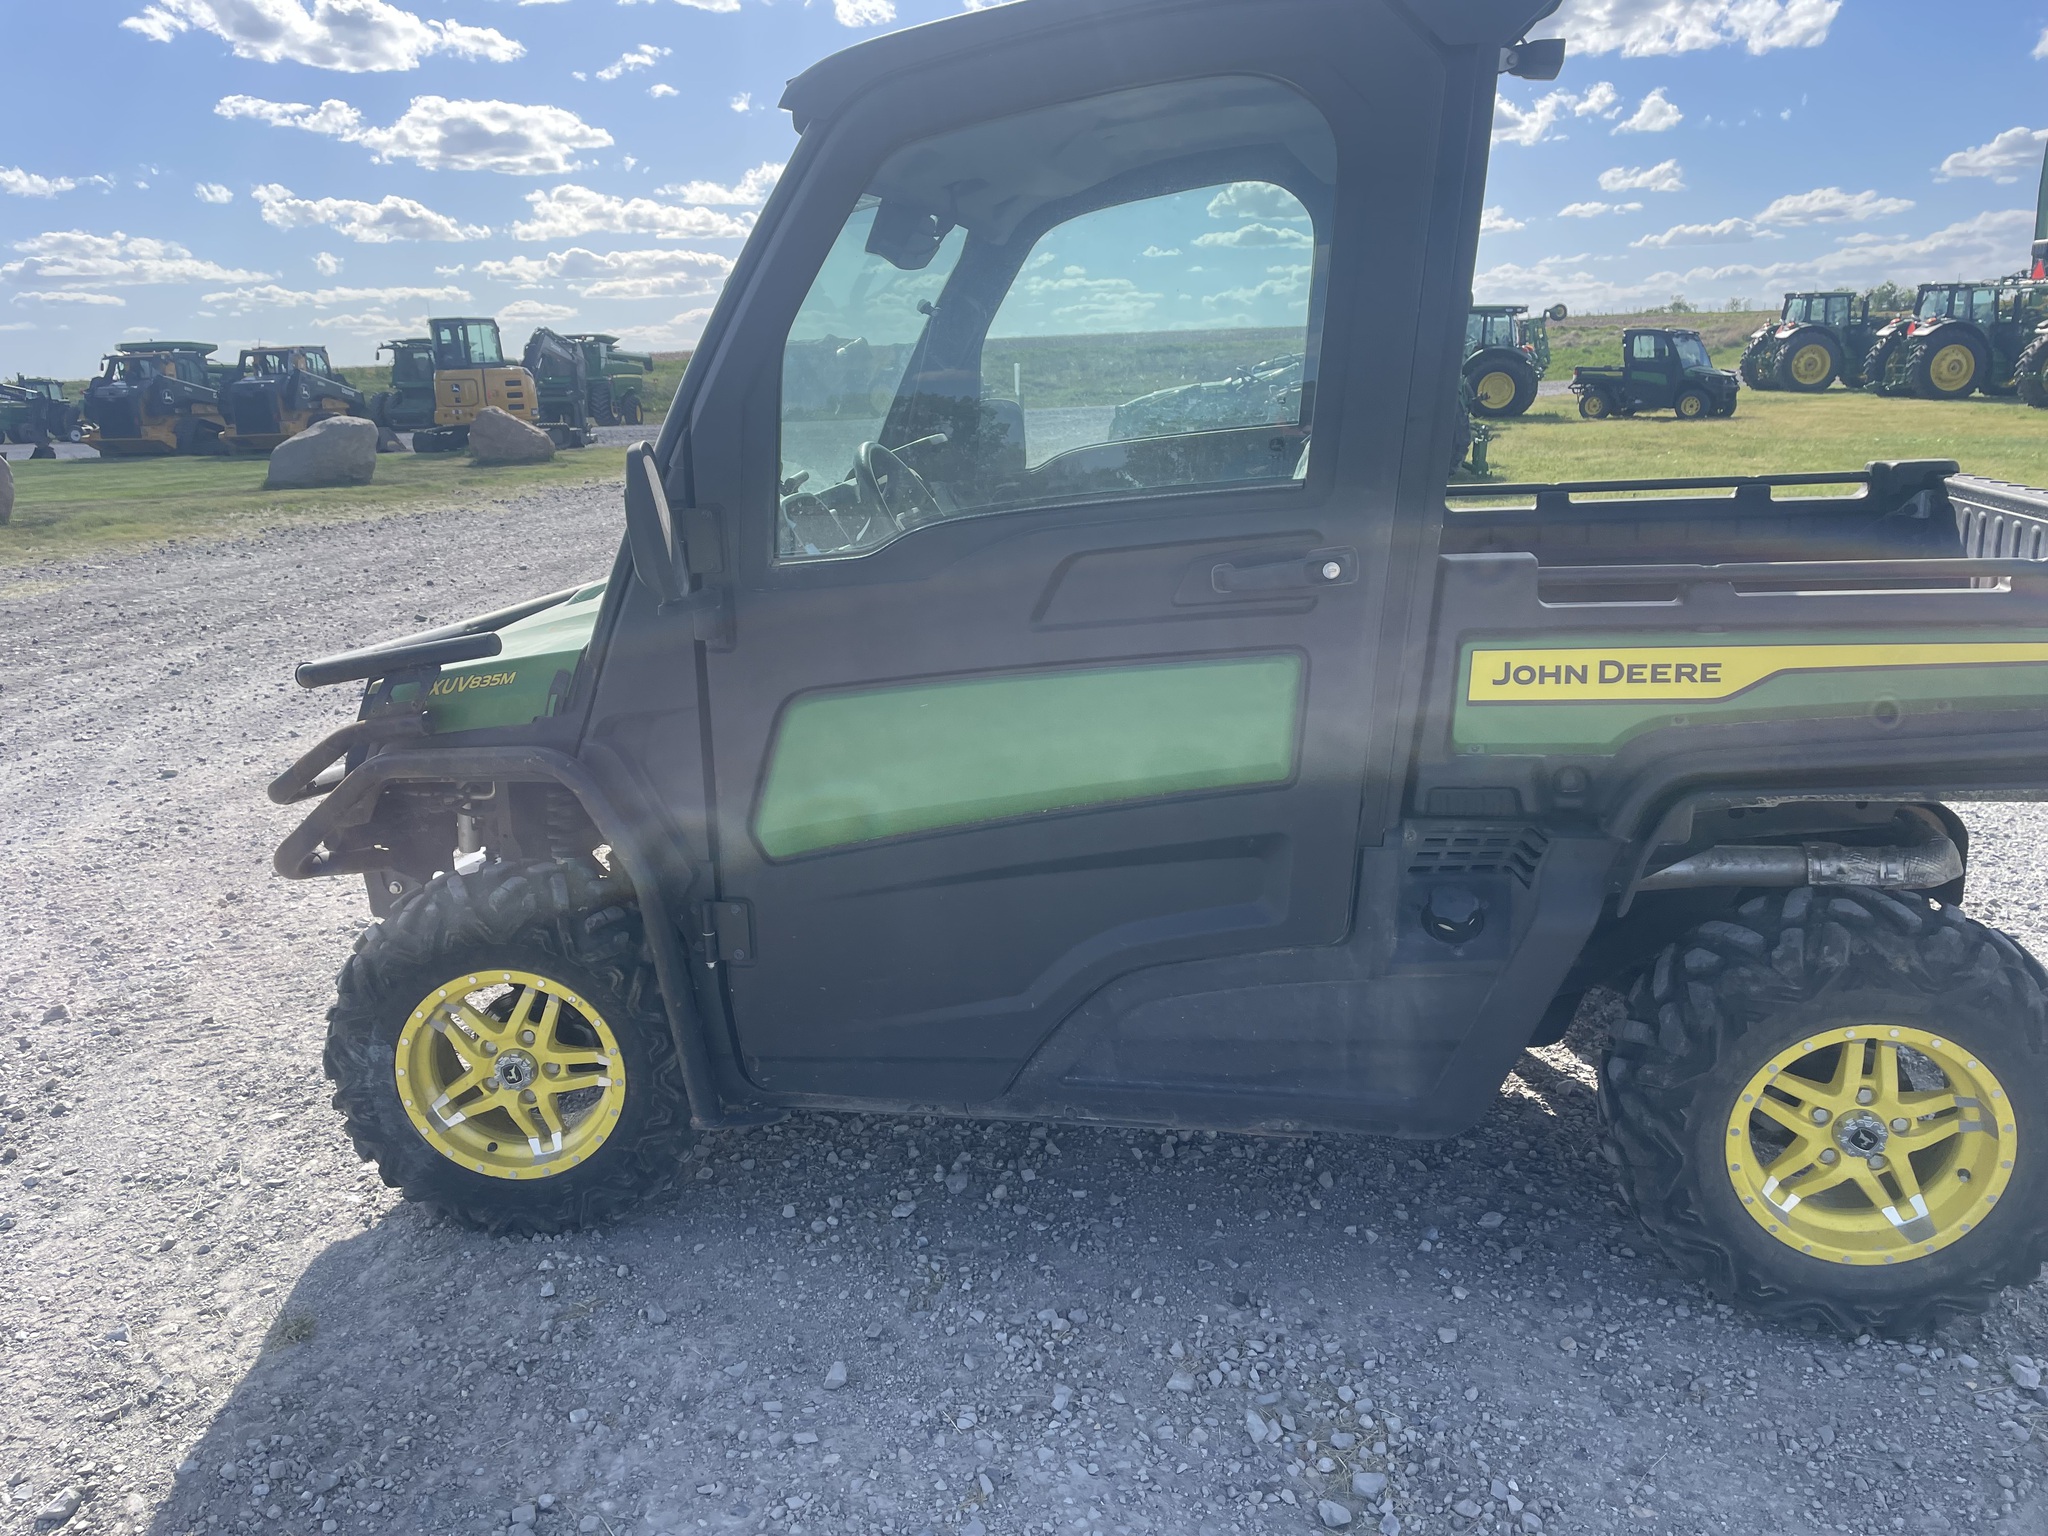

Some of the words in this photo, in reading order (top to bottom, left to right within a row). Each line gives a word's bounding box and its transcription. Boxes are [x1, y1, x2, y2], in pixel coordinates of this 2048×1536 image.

[428, 671, 517, 696] XUV835M
[1492, 661, 1588, 686] JOHN
[1598, 659, 1722, 684] DEERE
